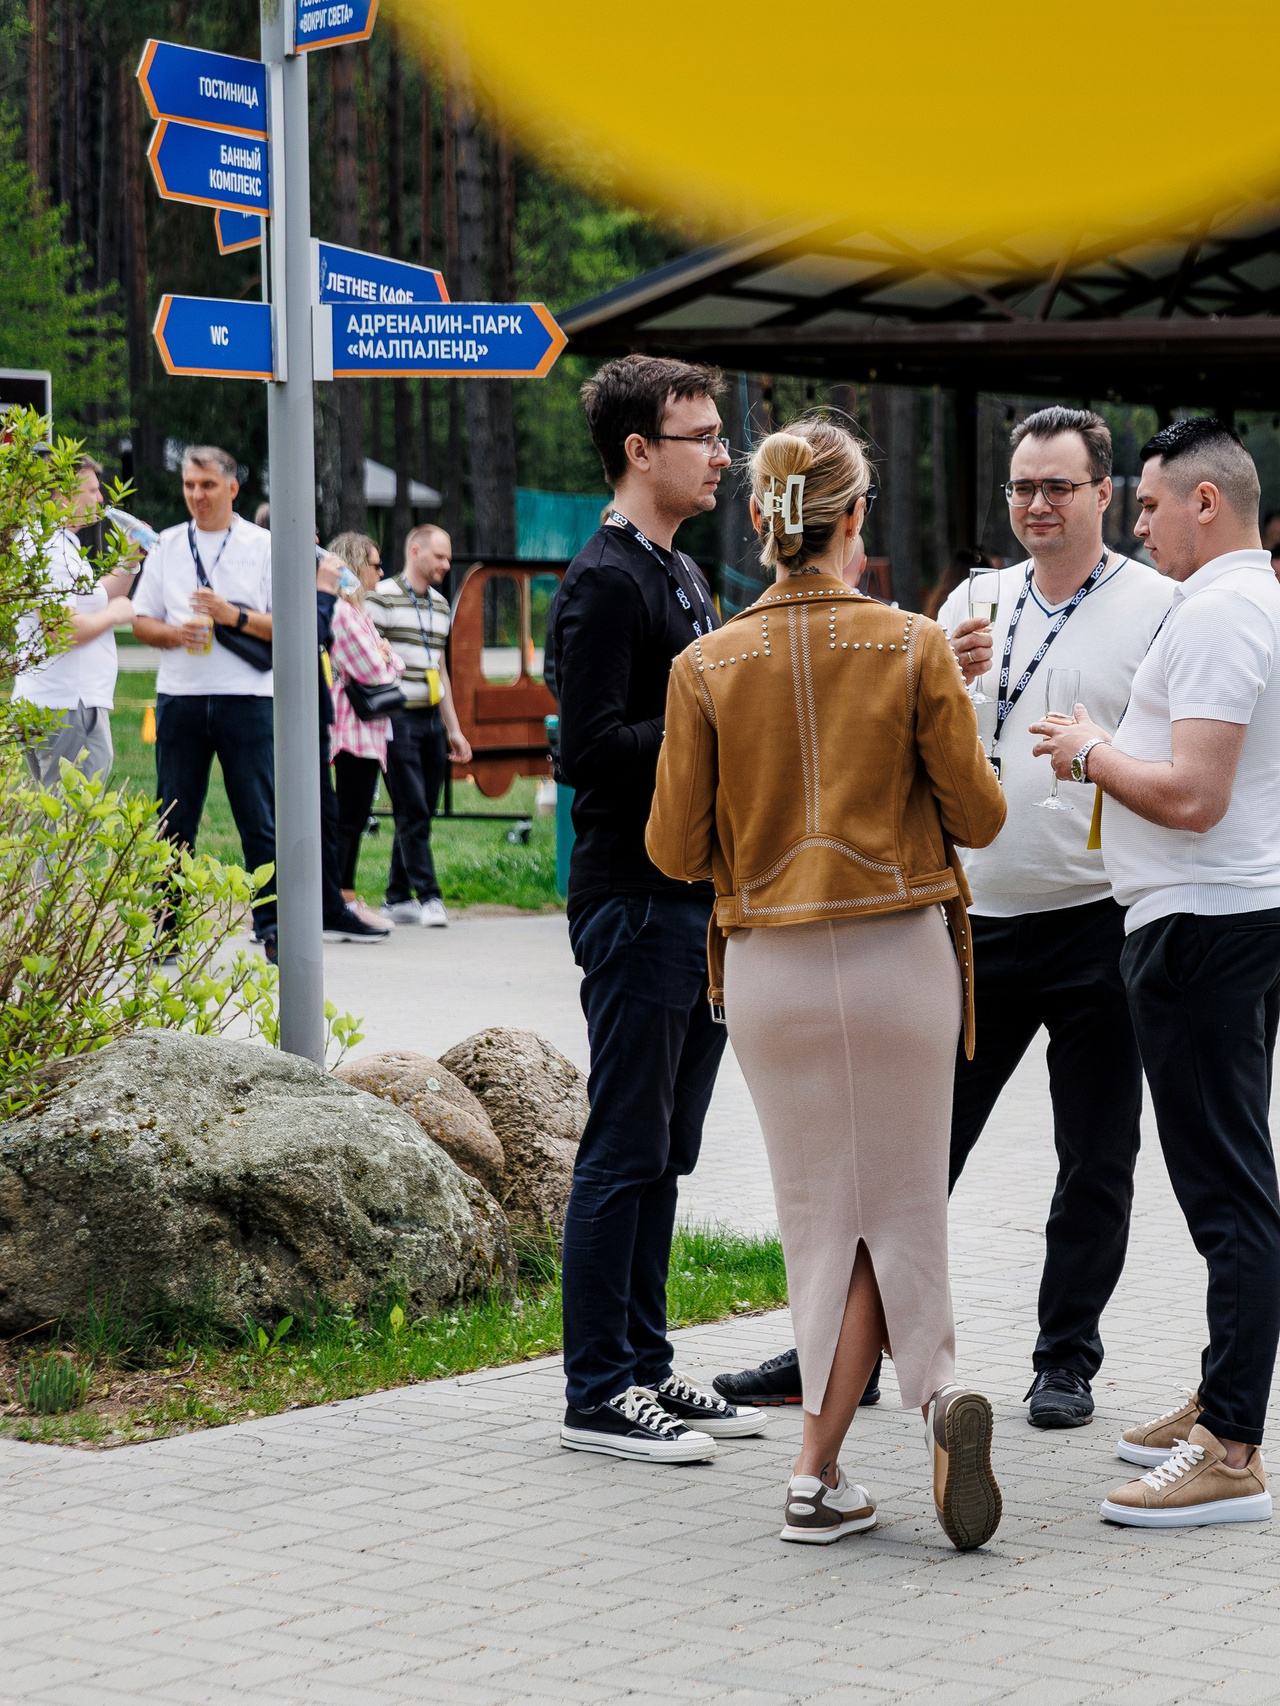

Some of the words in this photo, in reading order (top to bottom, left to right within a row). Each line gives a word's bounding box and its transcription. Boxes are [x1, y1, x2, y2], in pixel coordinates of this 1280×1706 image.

[327, 3, 354, 27] СВЕТА»
[199, 76, 259, 109] ГОСТИНИЦА
[220, 144, 262, 171] БАННЫЙ
[209, 168, 262, 197] КОМПЛЕКС
[326, 272, 377, 301] ЛЕТНЕЕ
[210, 325, 229, 346] WC
[346, 314, 523, 337] АДРЕНАЛИН-ПАРК
[347, 339, 489, 362] «МАЛПАЛЕНД»
